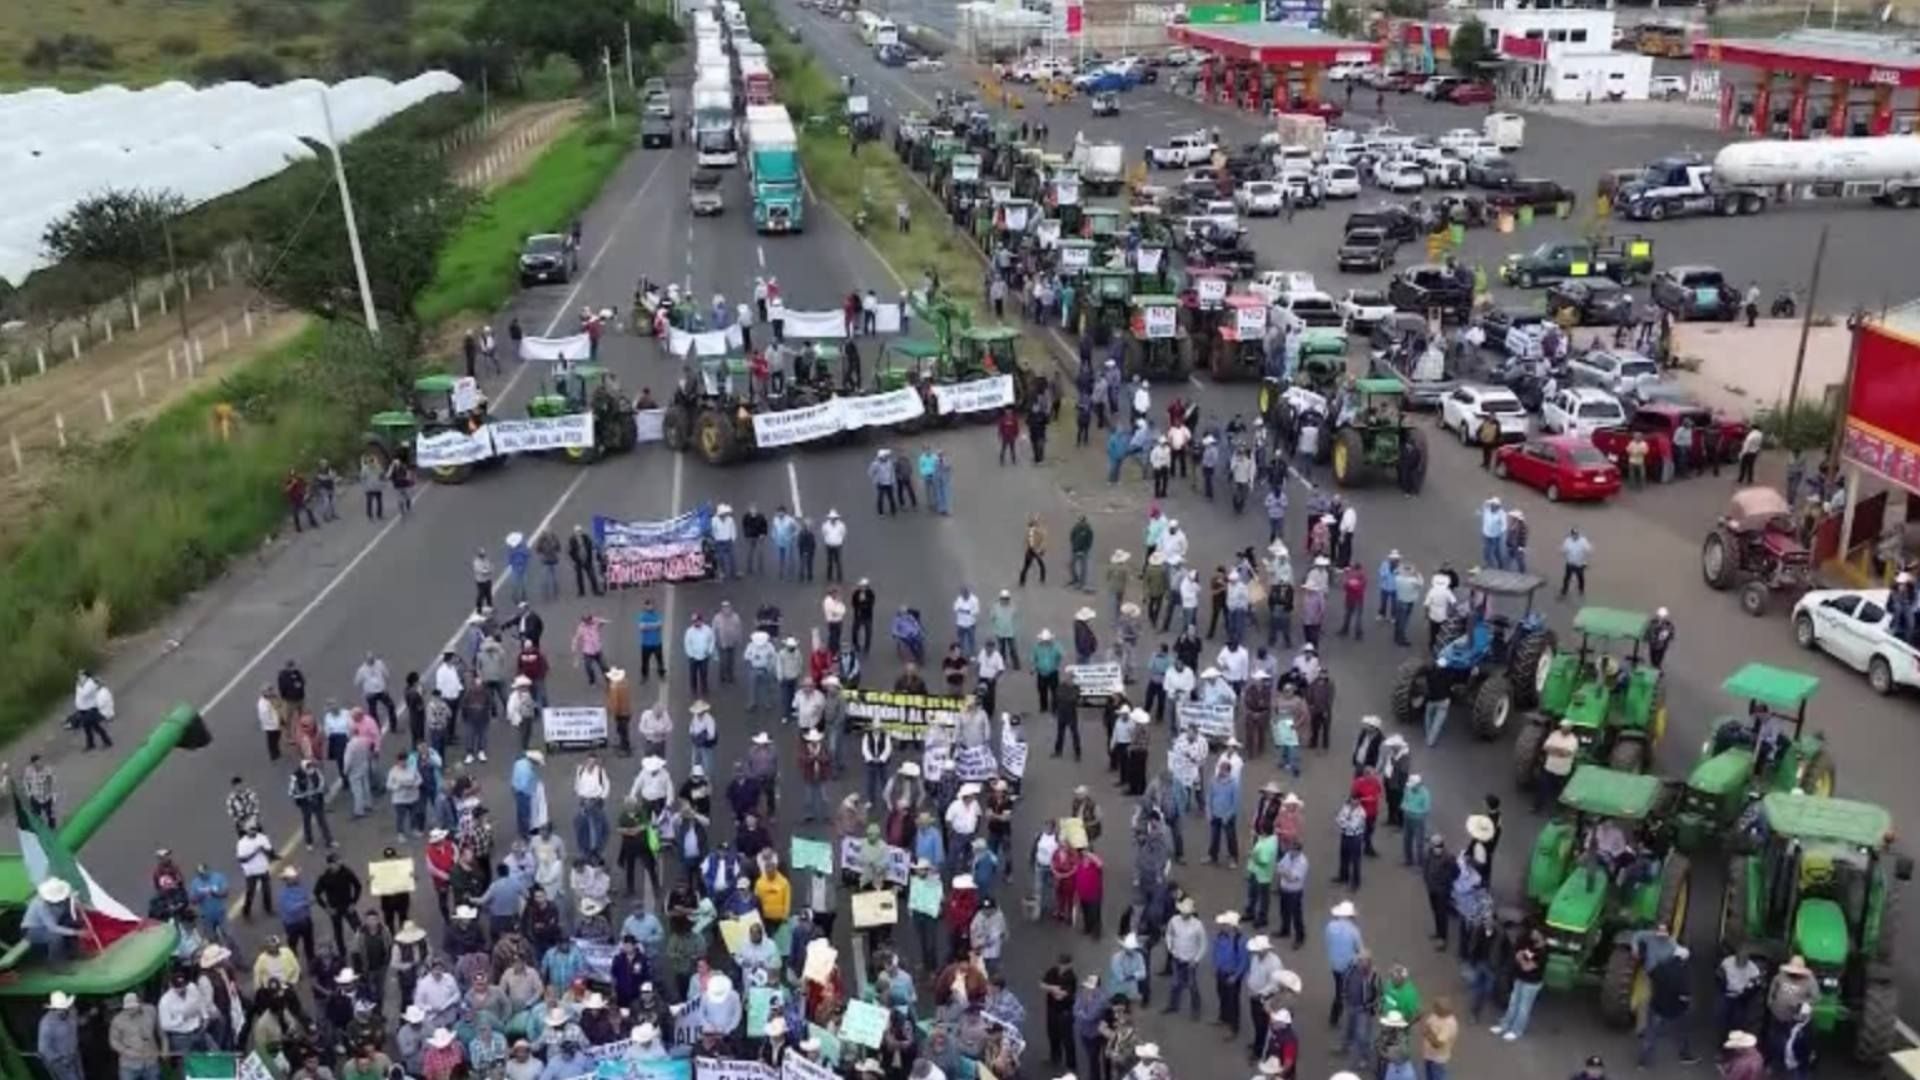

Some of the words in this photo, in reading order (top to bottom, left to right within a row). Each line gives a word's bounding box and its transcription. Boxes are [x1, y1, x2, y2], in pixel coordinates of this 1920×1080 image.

[1204, 282, 1224, 293] NO
[1152, 307, 1174, 320] NO
[1242, 308, 1264, 321] NO
